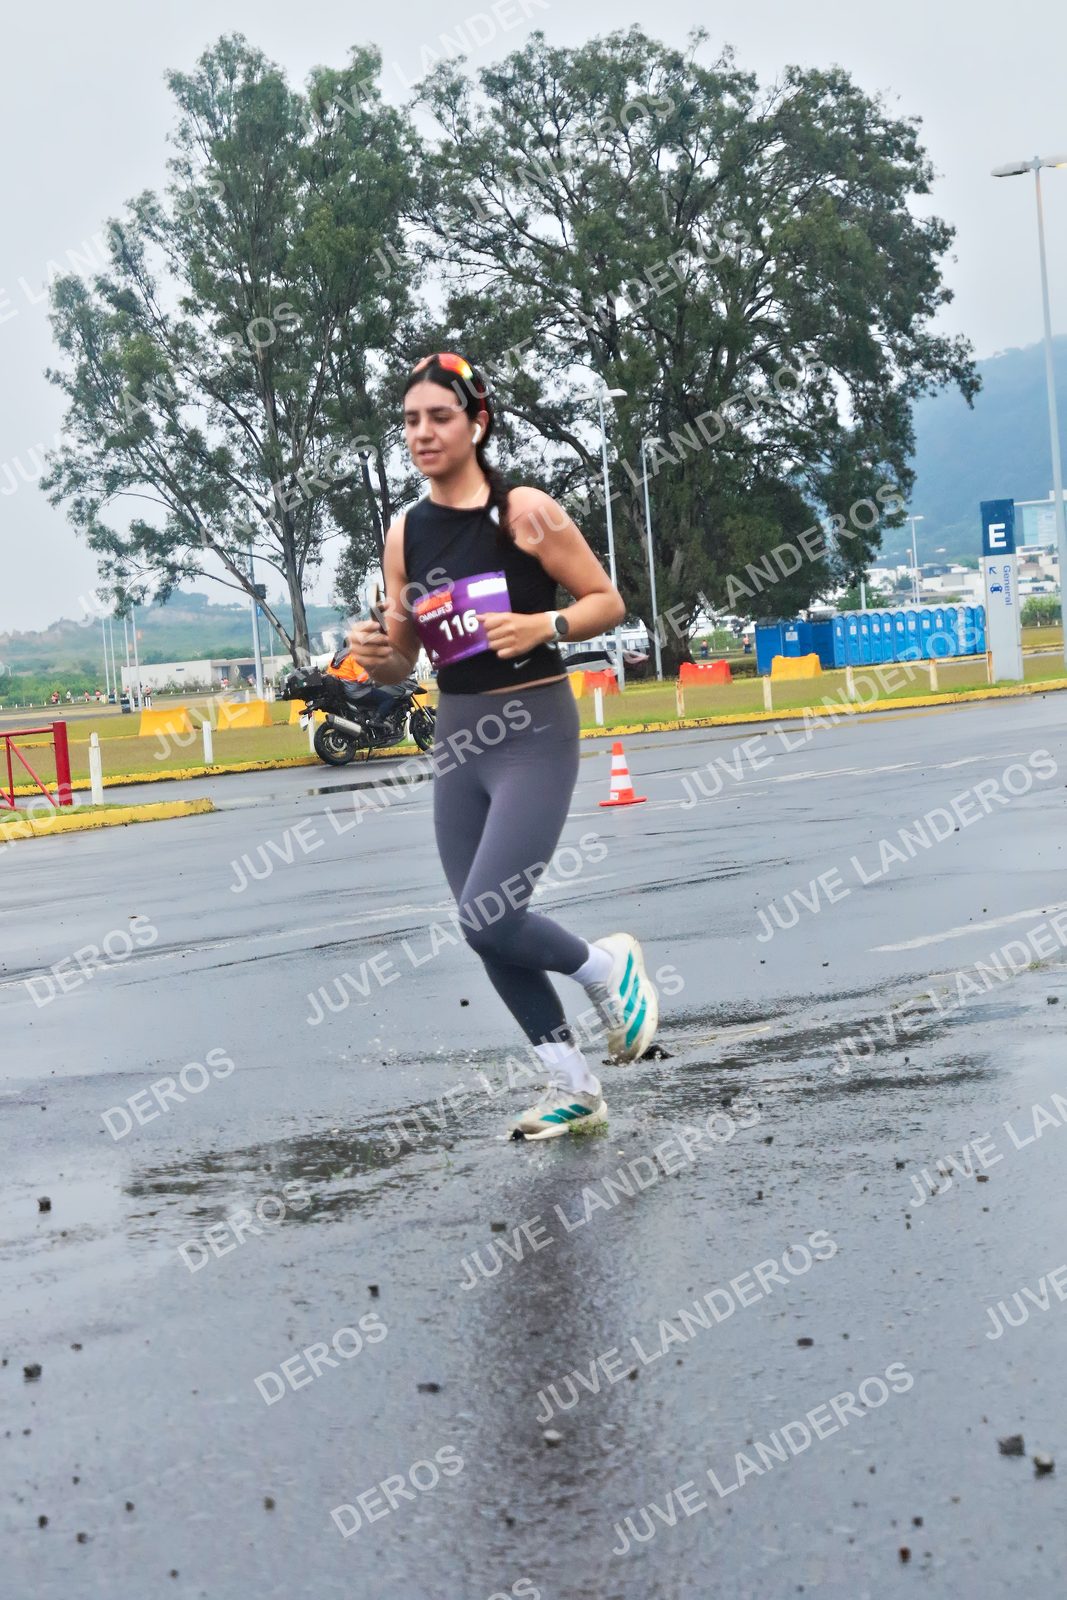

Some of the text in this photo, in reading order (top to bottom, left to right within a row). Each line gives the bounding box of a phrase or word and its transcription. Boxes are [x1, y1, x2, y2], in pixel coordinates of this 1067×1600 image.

[988, 523, 1007, 548] E
[1003, 565, 1012, 606] General
[439, 609, 479, 641] 116
